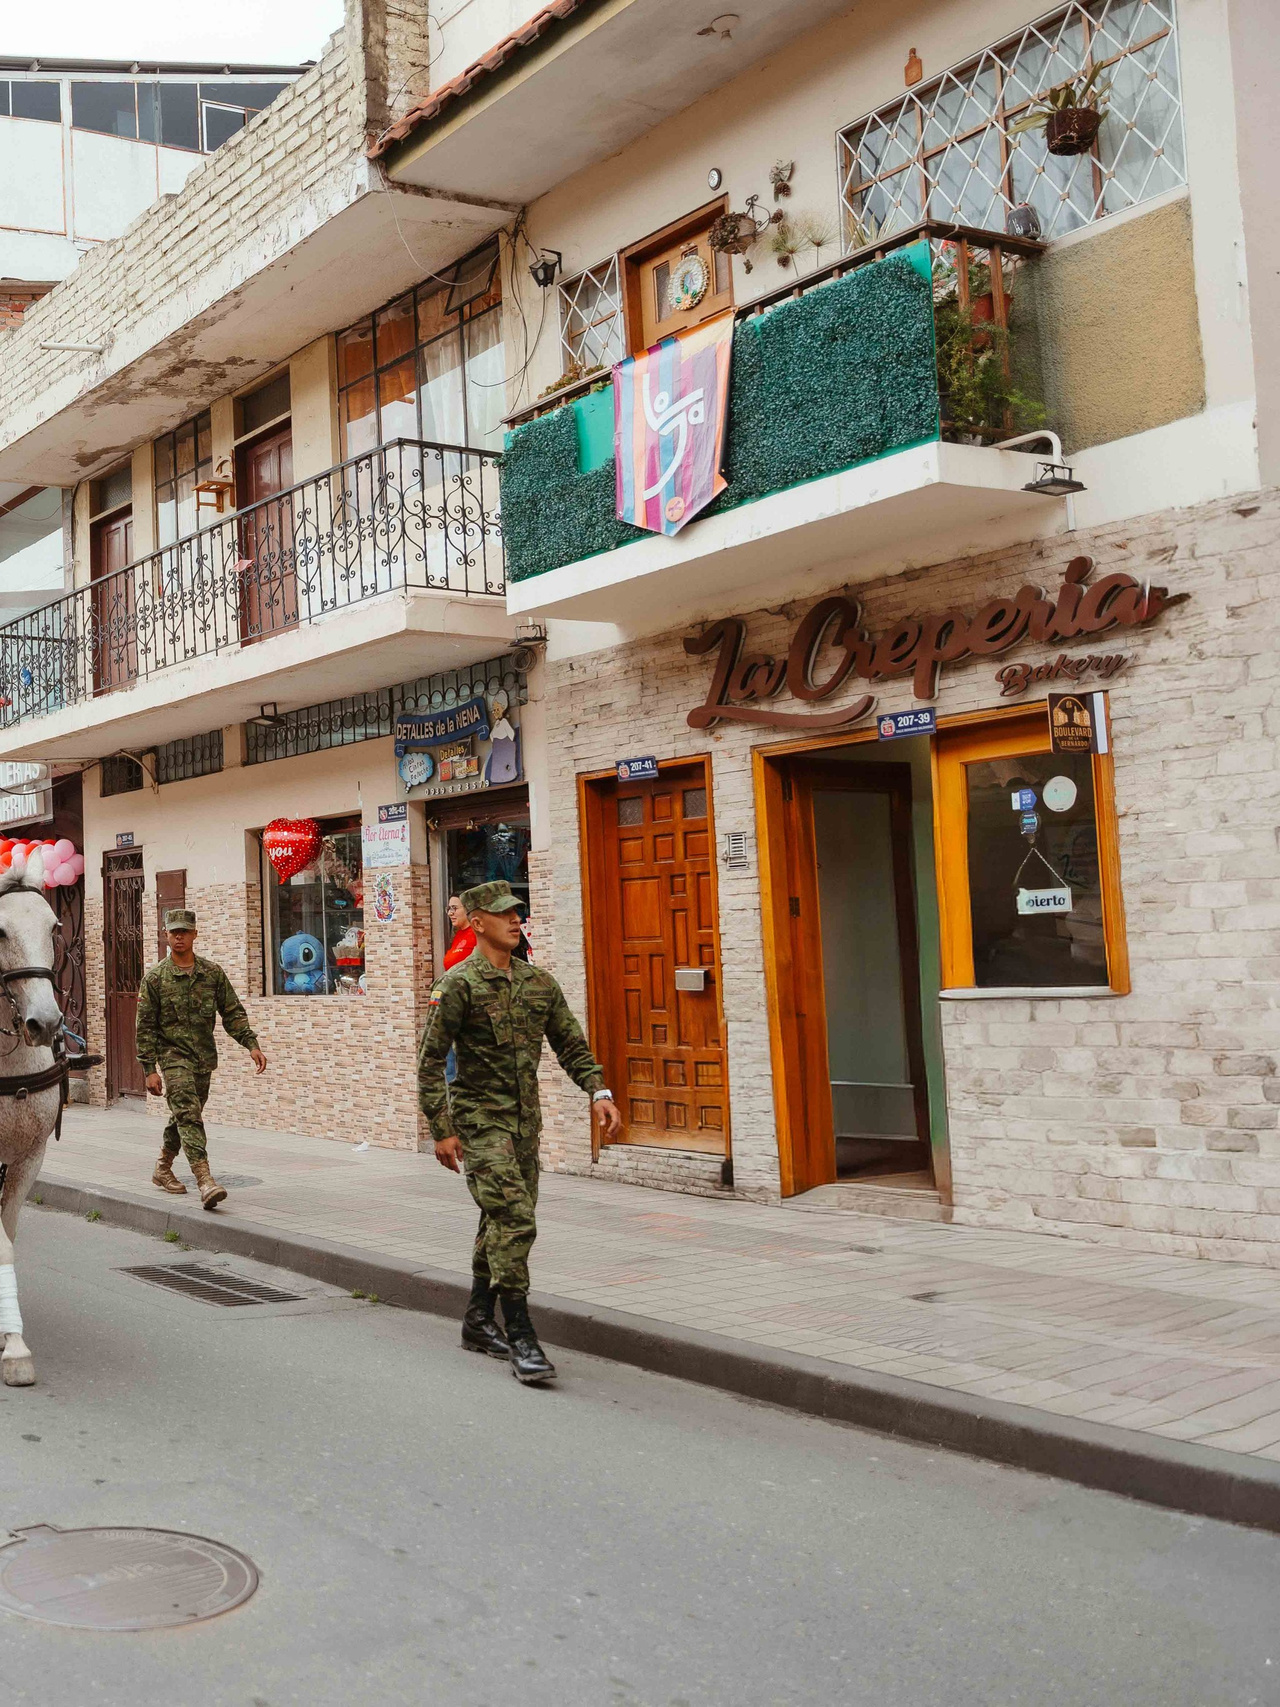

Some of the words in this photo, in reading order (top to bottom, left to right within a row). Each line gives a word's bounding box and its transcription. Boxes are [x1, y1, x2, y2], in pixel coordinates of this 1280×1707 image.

[683, 617, 878, 729] La
[787, 556, 1168, 700] Creperia
[995, 652, 1133, 698] Bakery
[397, 721, 434, 741] DETALLES
[435, 721, 446, 736] de
[446, 717, 455, 733] la
[456, 704, 481, 730] NENA
[897, 712, 931, 728] 207-39
[1053, 726, 1093, 738] BOULEVARD
[440, 744, 465, 761] Detalles
[630, 760, 653, 771] 207-41
[269, 846, 293, 861] you
